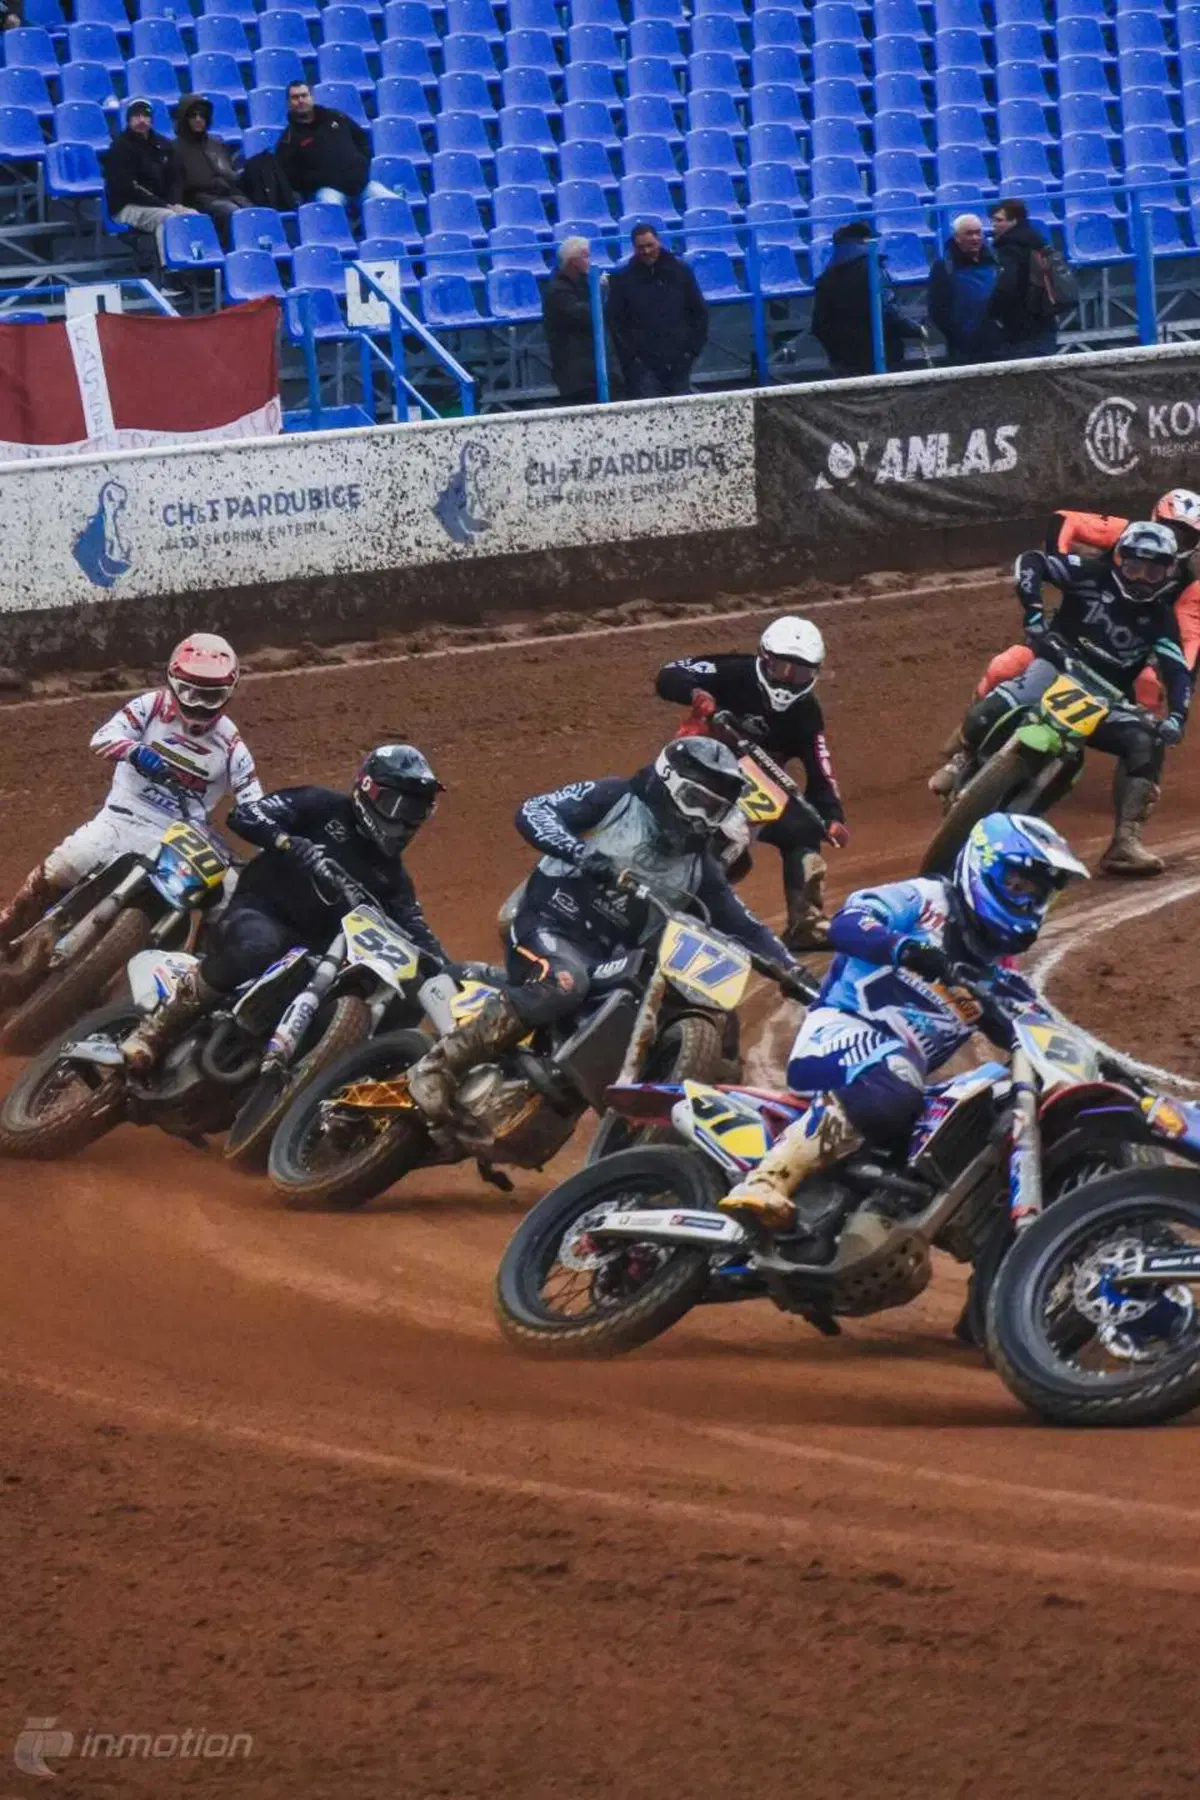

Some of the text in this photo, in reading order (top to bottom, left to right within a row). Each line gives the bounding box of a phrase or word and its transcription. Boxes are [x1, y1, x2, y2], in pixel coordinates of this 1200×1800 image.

[1149, 402, 1200, 439] KO
[873, 425, 1020, 484] ANLAS
[224, 484, 361, 520] PARDUBICE
[1046, 688, 1103, 724] 41
[168, 831, 226, 878] 20
[352, 928, 411, 970] 52
[668, 931, 744, 986] 17
